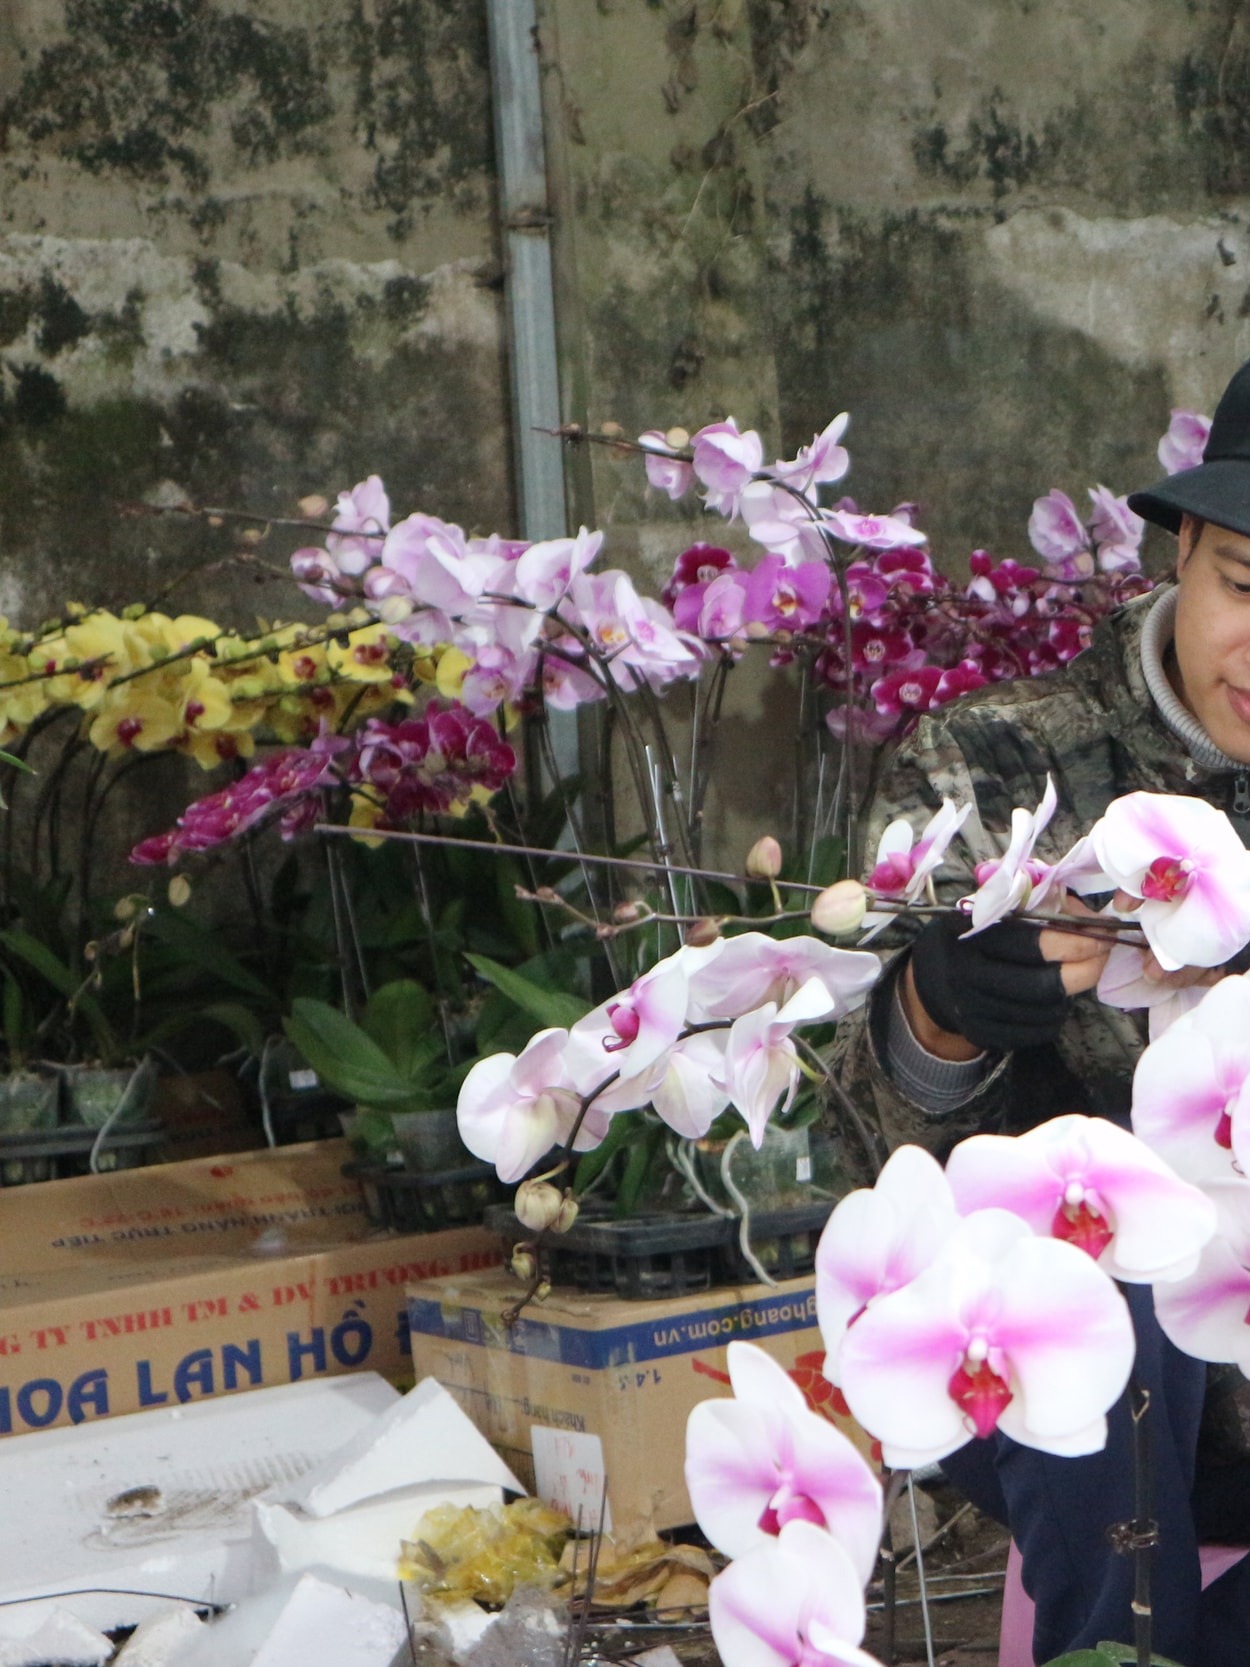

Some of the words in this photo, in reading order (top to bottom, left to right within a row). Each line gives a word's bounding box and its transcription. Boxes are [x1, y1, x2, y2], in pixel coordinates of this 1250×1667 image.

[30, 1322, 72, 1350] TY
[80, 1306, 173, 1341] TNHH
[182, 1297, 228, 1322] TM
[238, 1291, 261, 1313] &
[273, 1277, 317, 1305] DV
[136, 1338, 264, 1404] LAN
[286, 1299, 373, 1382] HỒ
